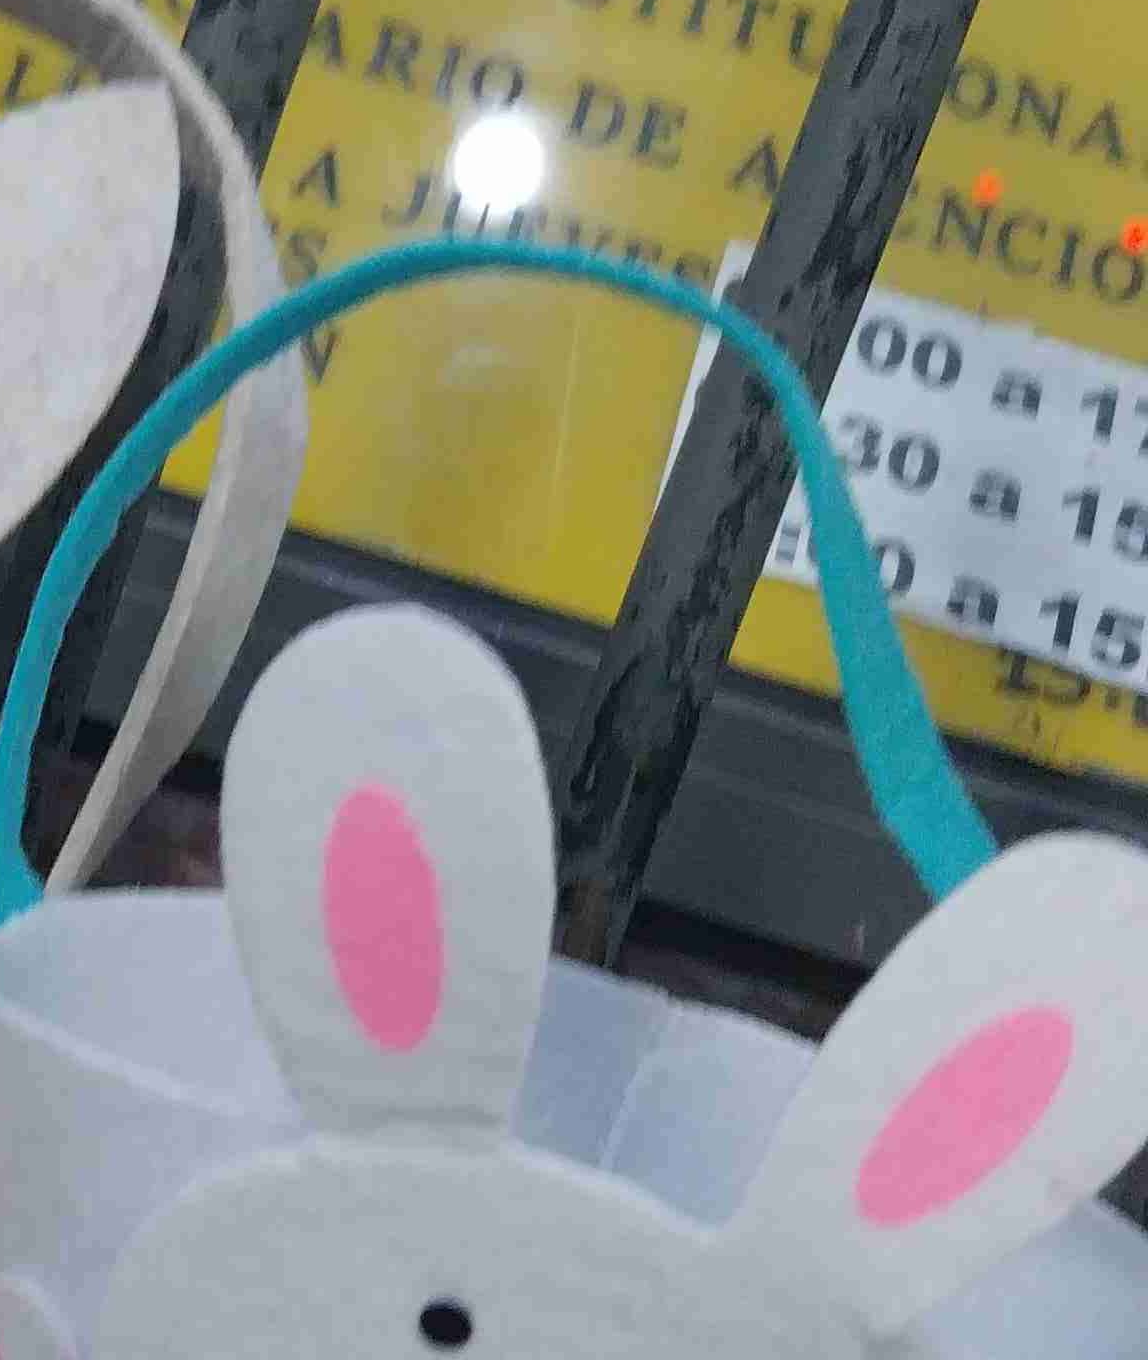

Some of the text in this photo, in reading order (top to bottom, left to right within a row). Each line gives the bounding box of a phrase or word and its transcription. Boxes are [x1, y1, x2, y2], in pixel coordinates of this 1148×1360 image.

[566, 80, 688, 170] DE
[291, 146, 343, 208] A
[989, 367, 1044, 421] a
[968, 467, 1022, 522] a
[945, 575, 999, 627] a
